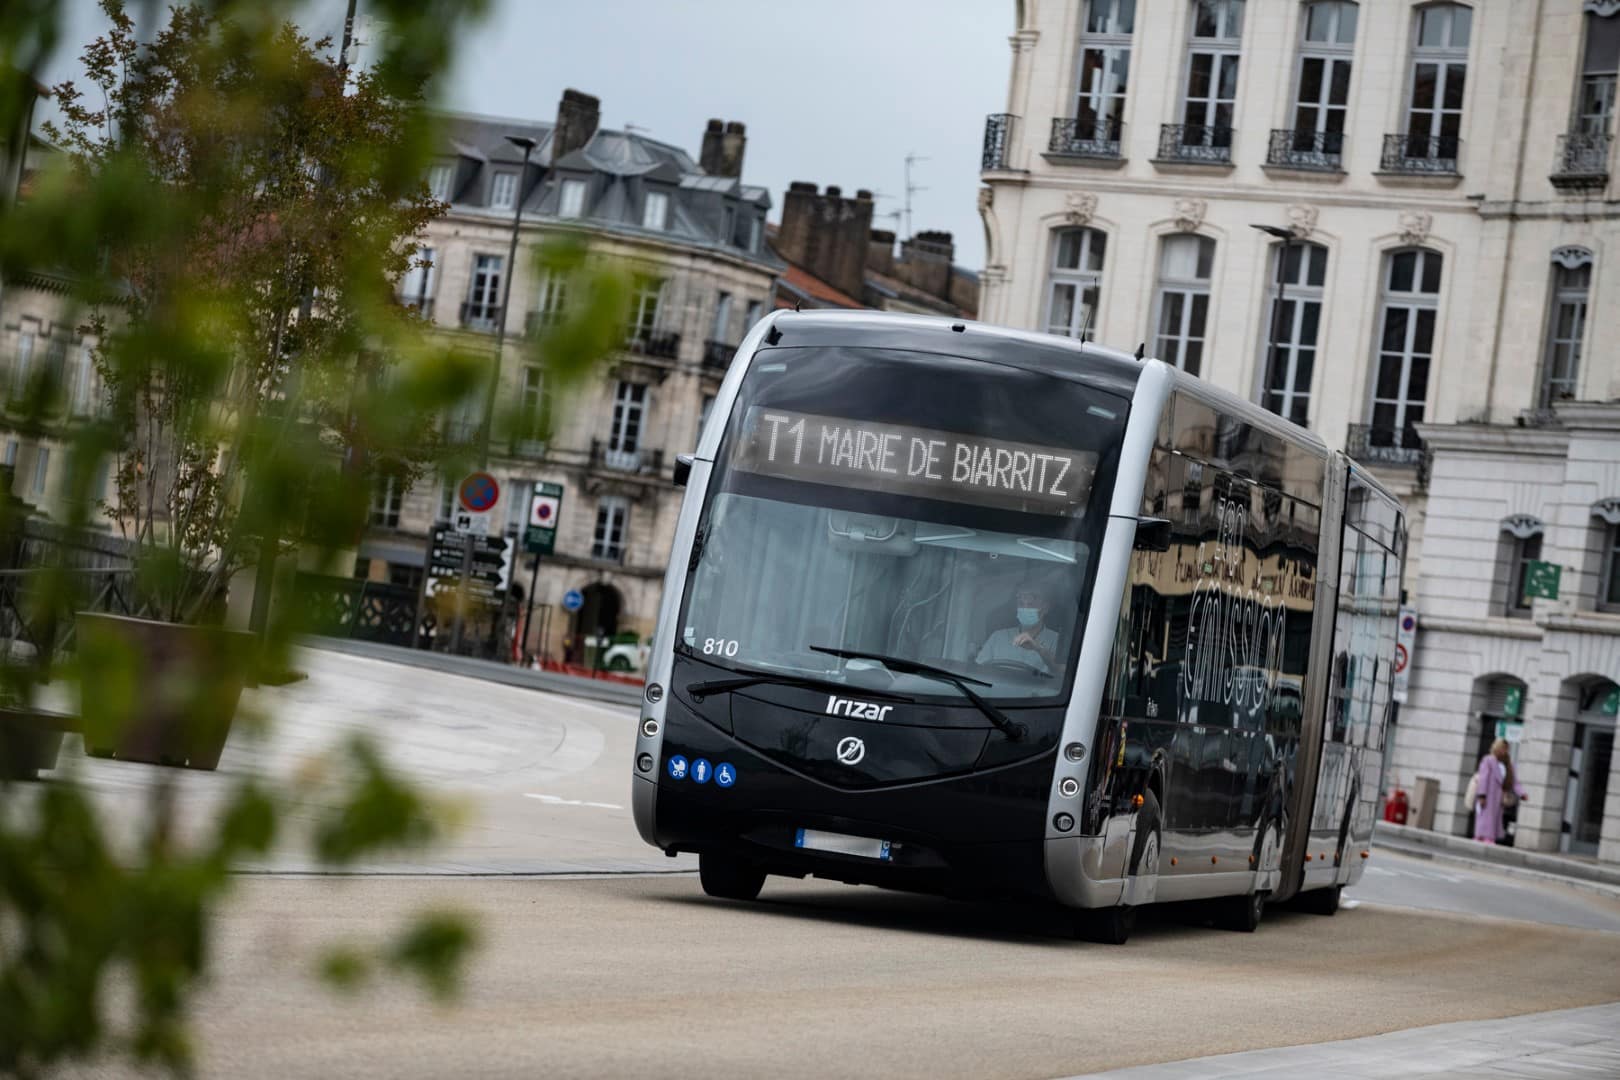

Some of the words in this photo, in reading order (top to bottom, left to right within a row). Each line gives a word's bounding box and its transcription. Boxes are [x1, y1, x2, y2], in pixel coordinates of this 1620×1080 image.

[764, 414, 806, 465] T1
[818, 425, 902, 475] MAIRIE
[907, 437, 947, 480] DE
[952, 443, 1072, 496] BIARRITZ
[702, 638, 739, 657] 810
[825, 695, 894, 721] Irizar
